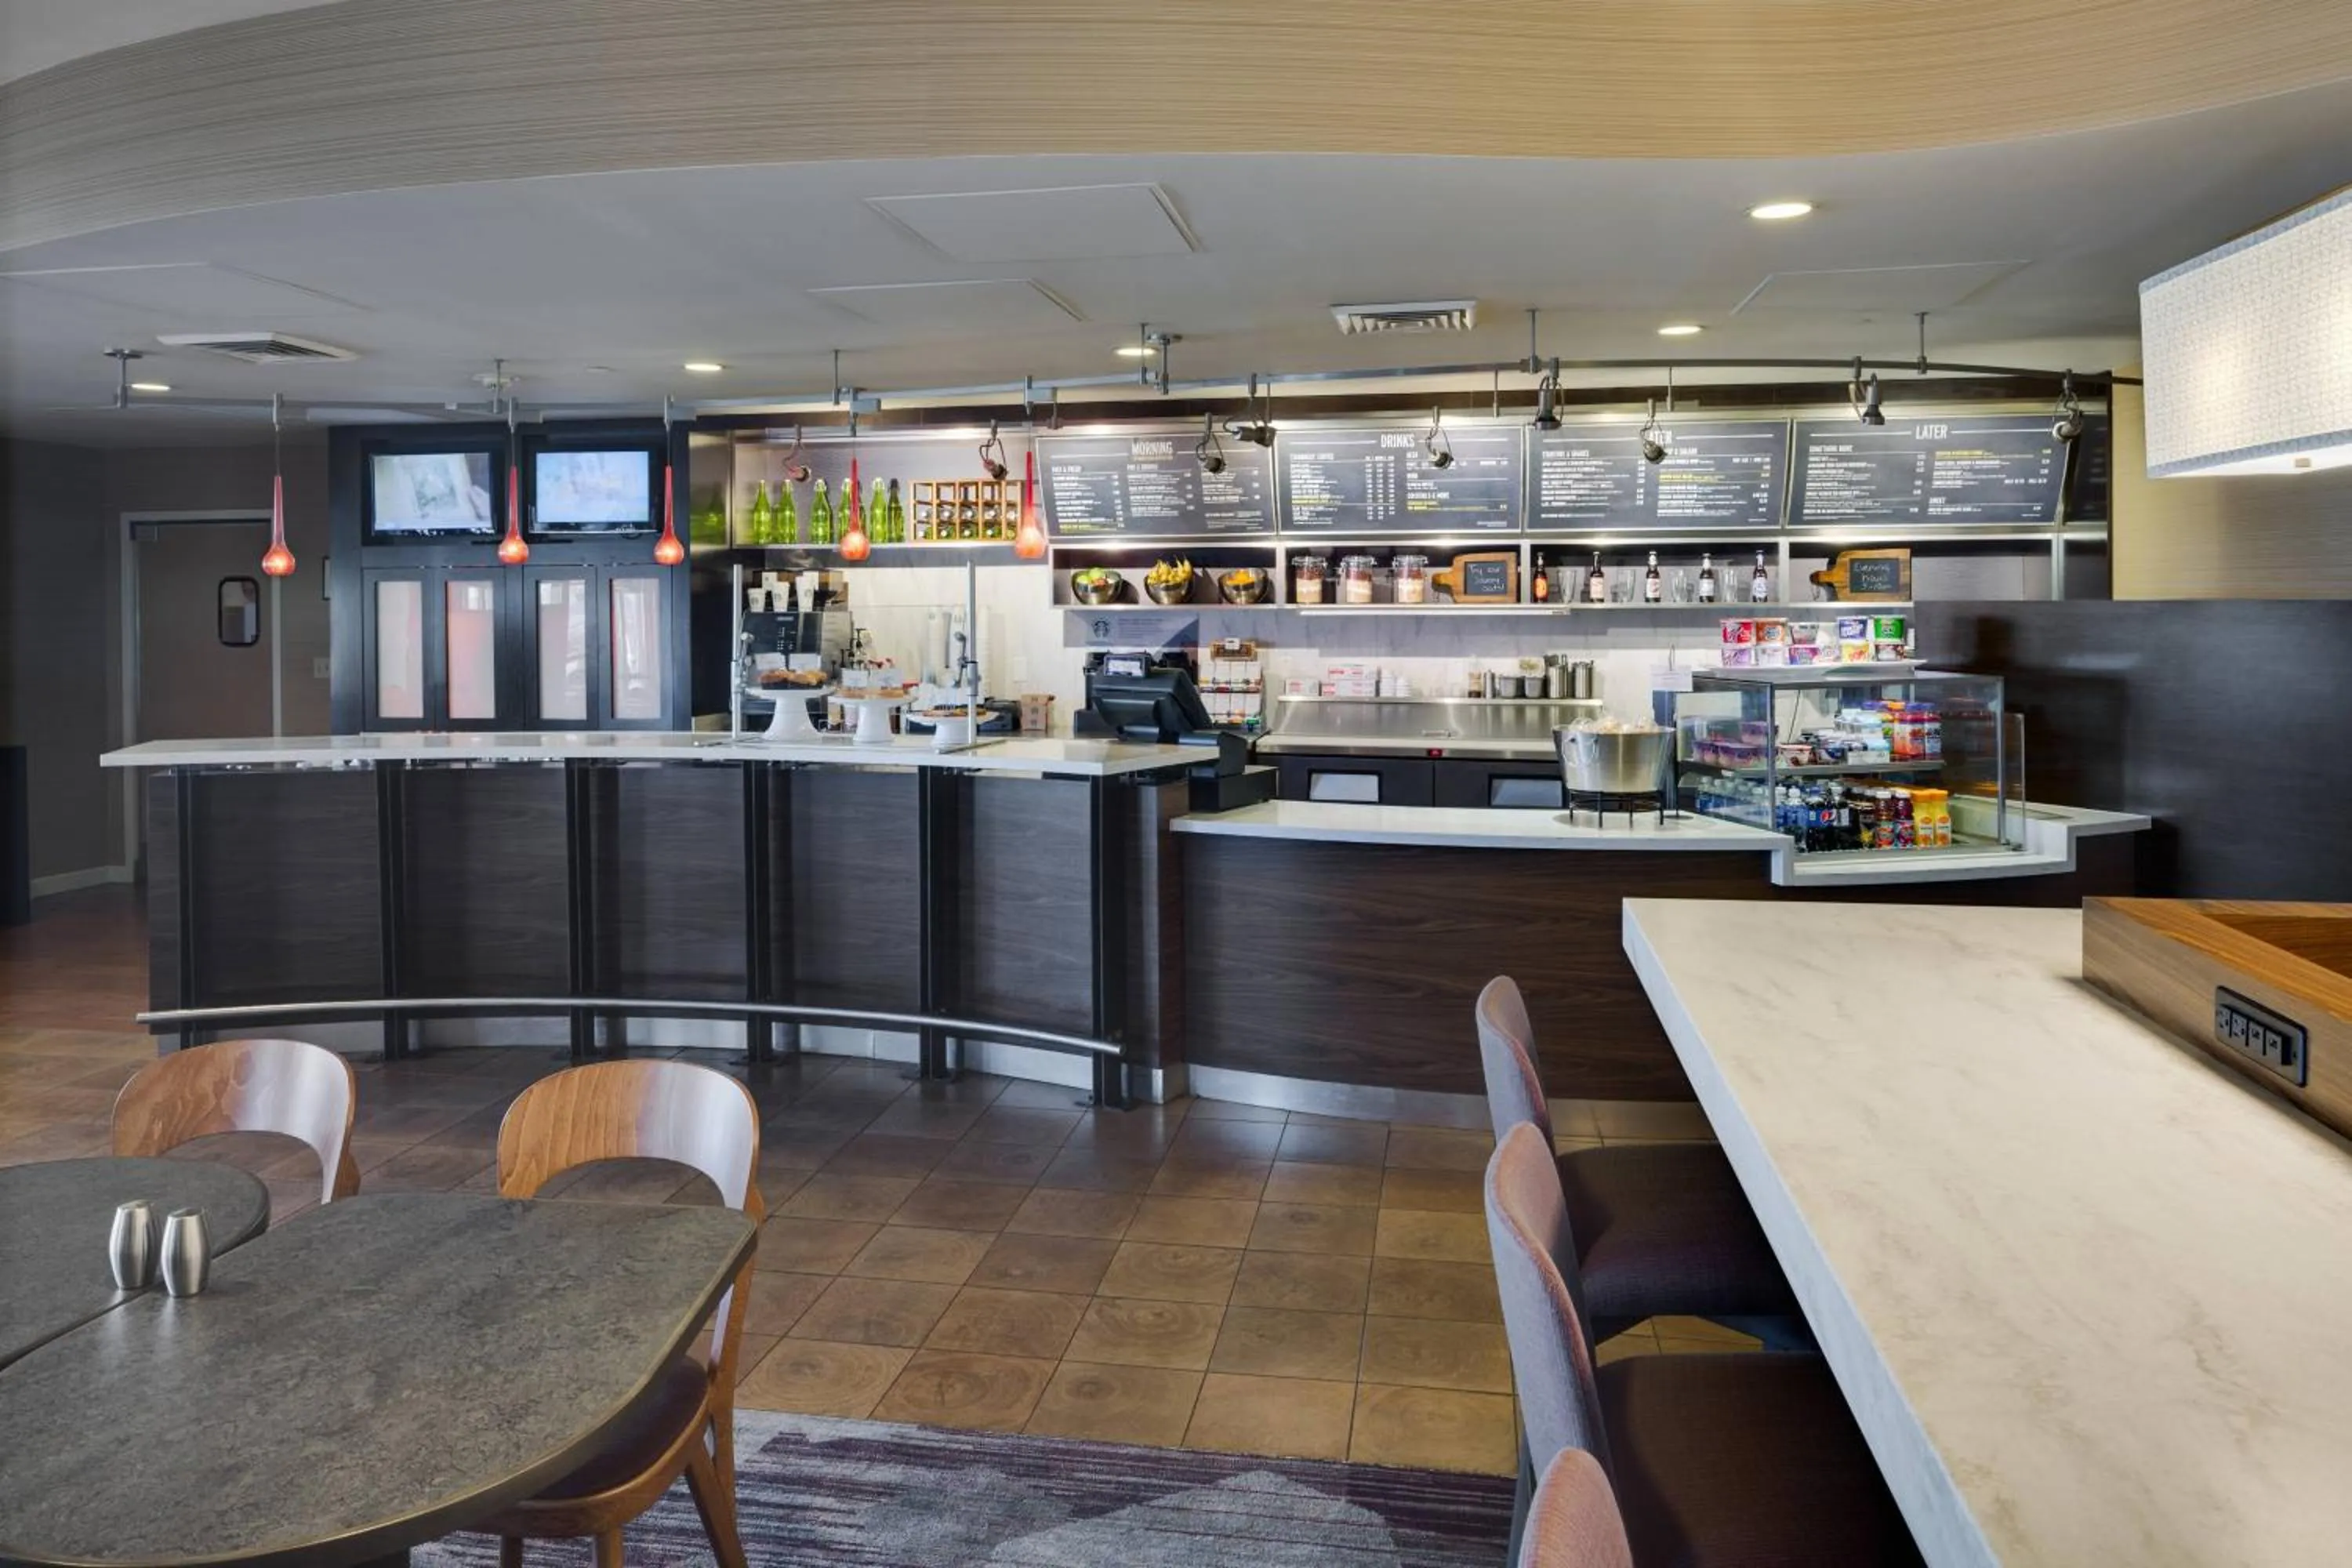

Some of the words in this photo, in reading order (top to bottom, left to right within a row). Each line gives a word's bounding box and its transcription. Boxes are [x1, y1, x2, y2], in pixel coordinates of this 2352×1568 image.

[1915, 424, 1949, 440] LATER
[1131, 441, 1174, 456] MORNING
[1380, 434, 1415, 448] DRINKS
